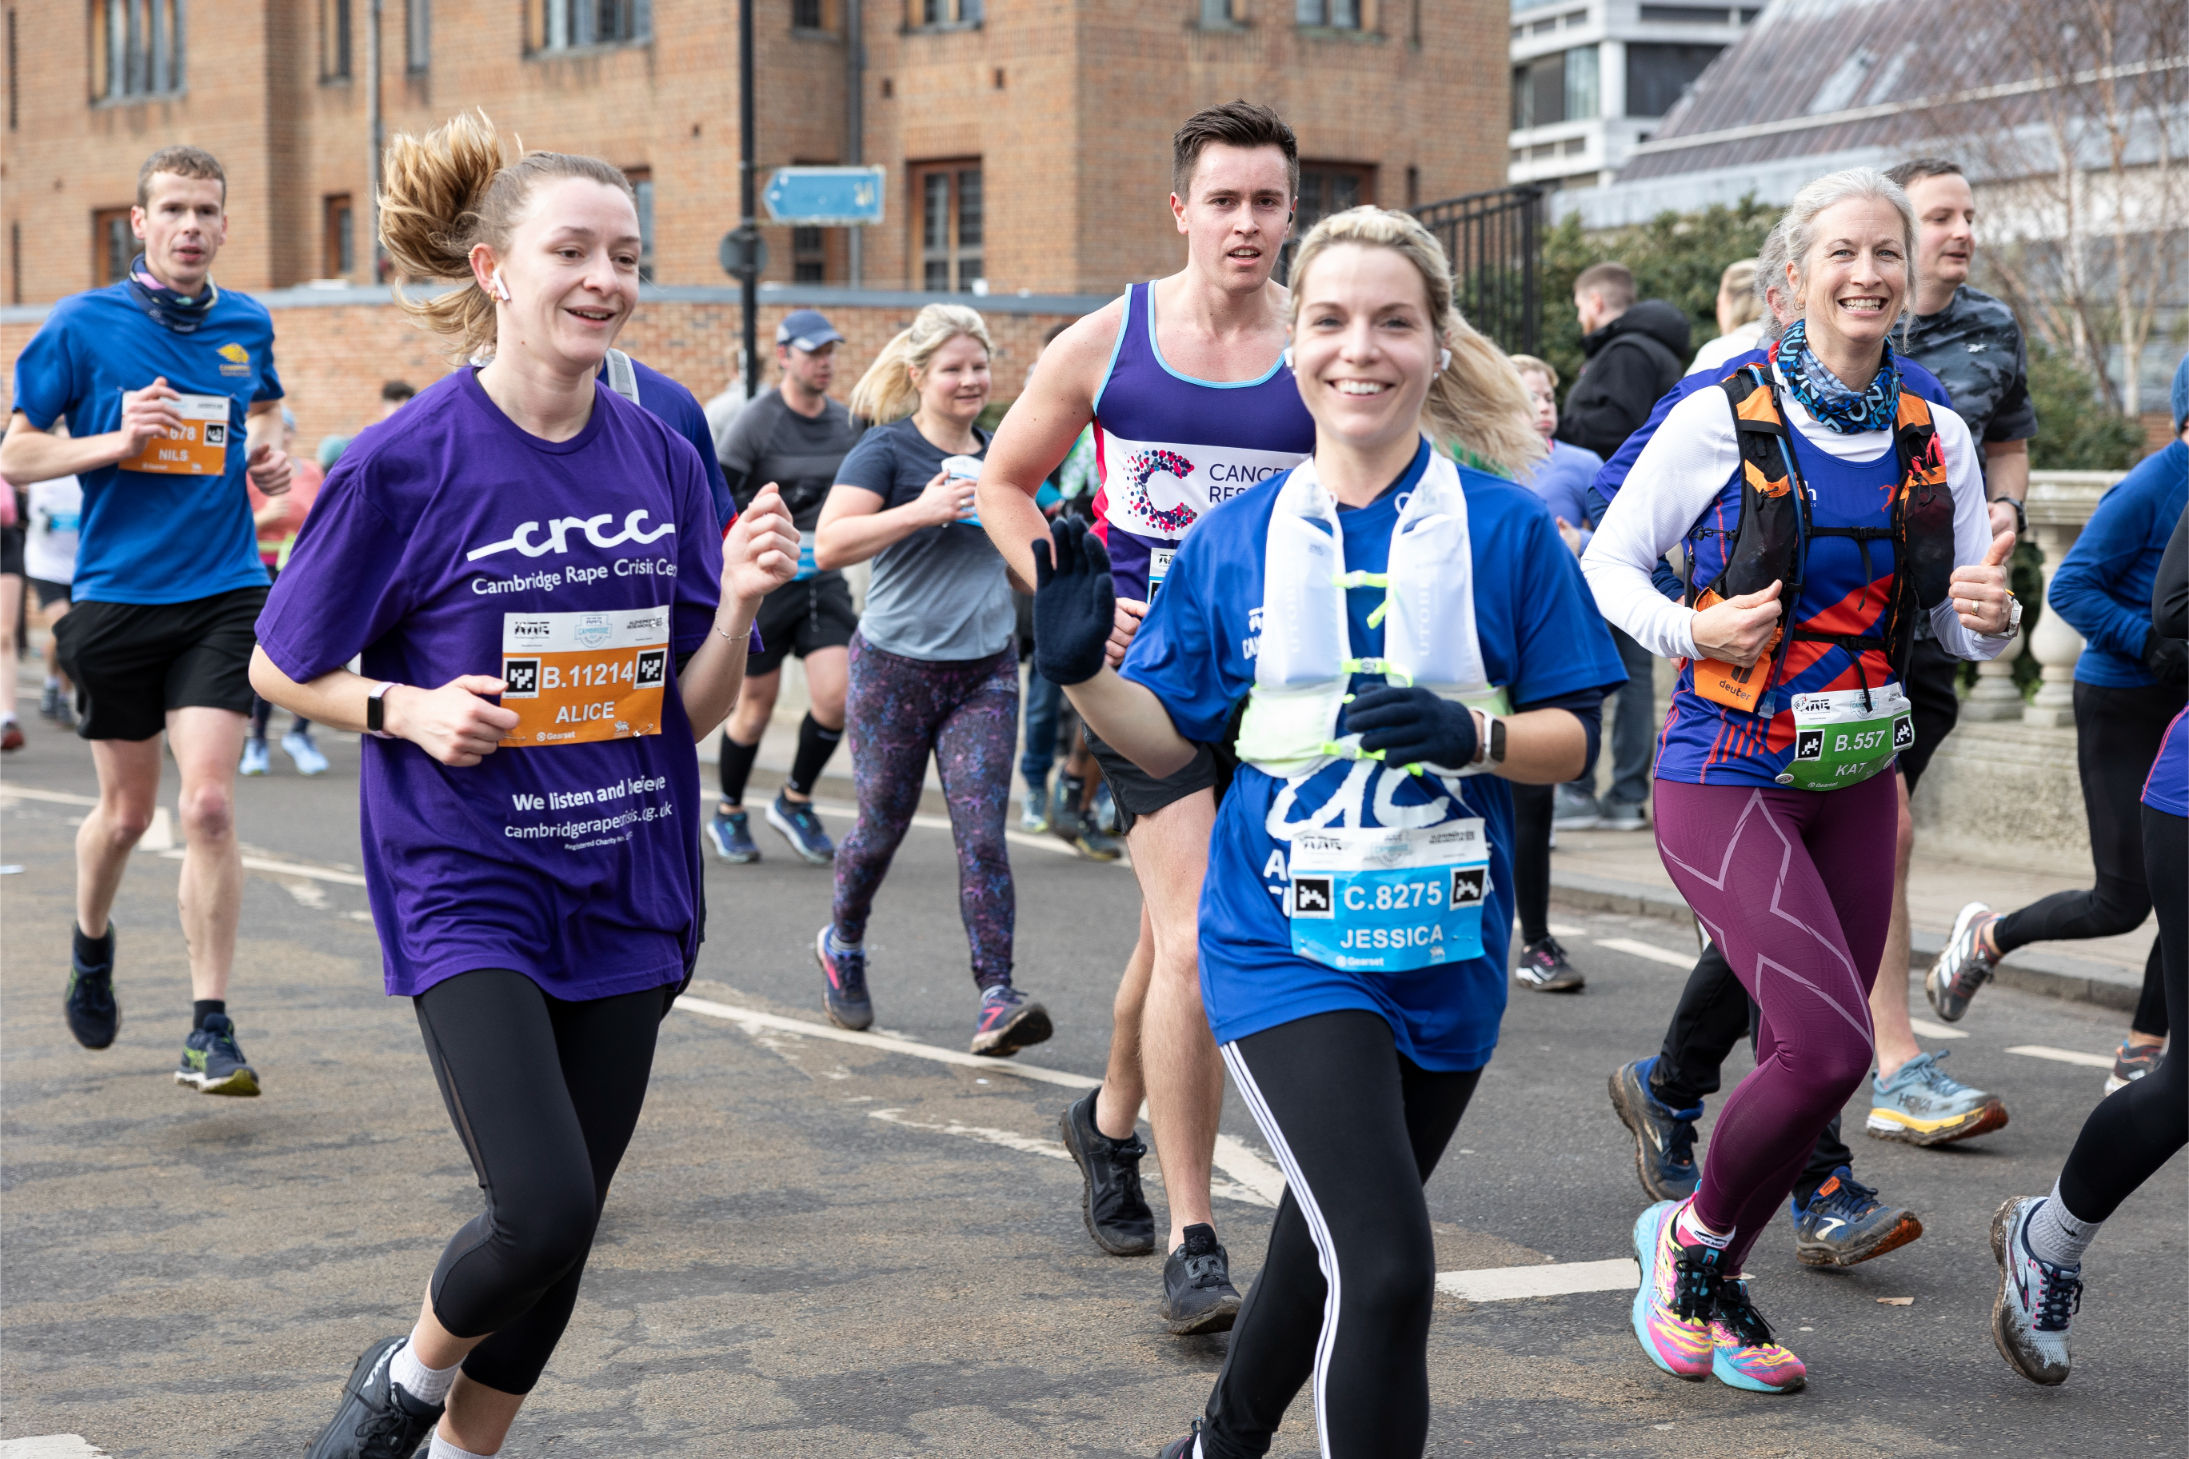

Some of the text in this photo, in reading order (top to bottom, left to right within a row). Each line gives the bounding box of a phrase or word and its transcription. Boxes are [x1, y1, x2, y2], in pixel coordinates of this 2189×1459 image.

[158, 448, 189, 462] NILS
[1209, 463, 1283, 483] CANC
[471, 570, 563, 595] Cambridge
[565, 565, 609, 586] Rape
[613, 558, 655, 577] Crisis
[542, 660, 634, 690] B.11214
[1719, 680, 1752, 701] deuter
[554, 701, 616, 724] ALICE
[1834, 730, 1886, 753] B.557
[512, 793, 546, 812] We
[549, 790, 595, 811] listen
[597, 779, 626, 802] and
[1343, 881, 1443, 911] C.8275
[1340, 924, 1444, 950] JESSICA
